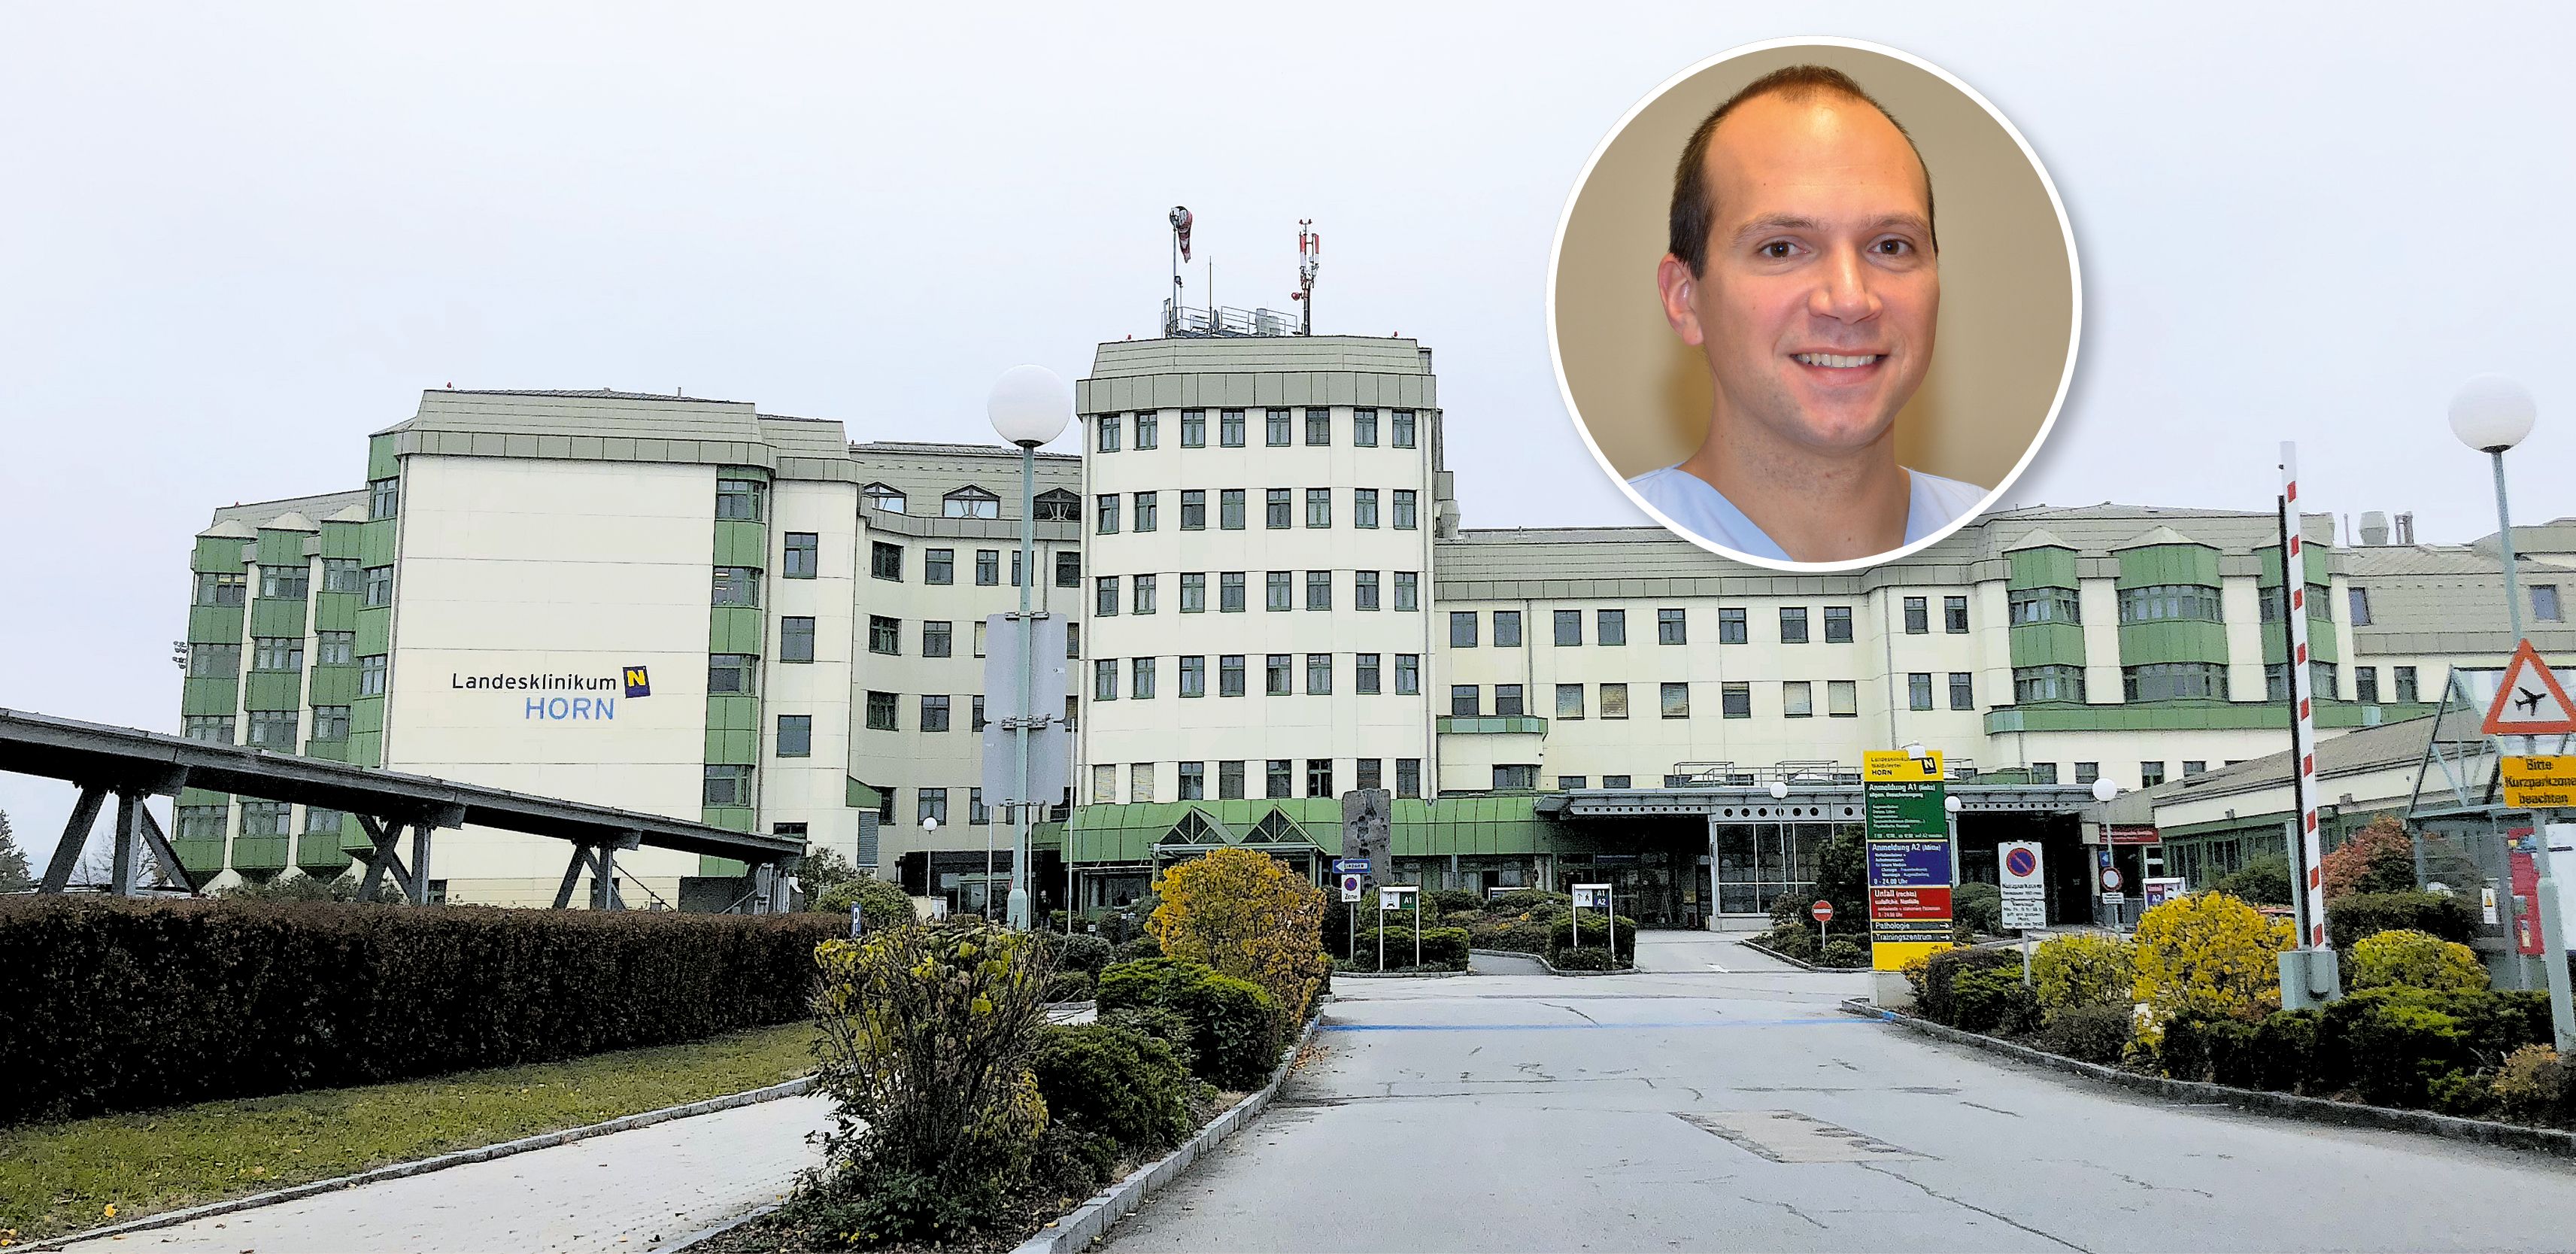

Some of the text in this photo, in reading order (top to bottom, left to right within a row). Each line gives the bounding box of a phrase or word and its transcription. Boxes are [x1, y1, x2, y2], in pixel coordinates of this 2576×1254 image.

[452, 673, 617, 690] Landesklinikum
[525, 697, 614, 720] HORN
[2526, 759, 2553, 770] Bitte
[1868, 783, 1907, 792] Anmeldung
[2518, 792, 2568, 804] beachten
[1872, 843, 1910, 852] Anmeldung
[1874, 889, 1917, 898] Unfall (rechts)
[1403, 896, 1412, 904] A1
[1875, 922, 1910, 931] Pathologie
[1876, 934, 1932, 942] Trainingszentrum
